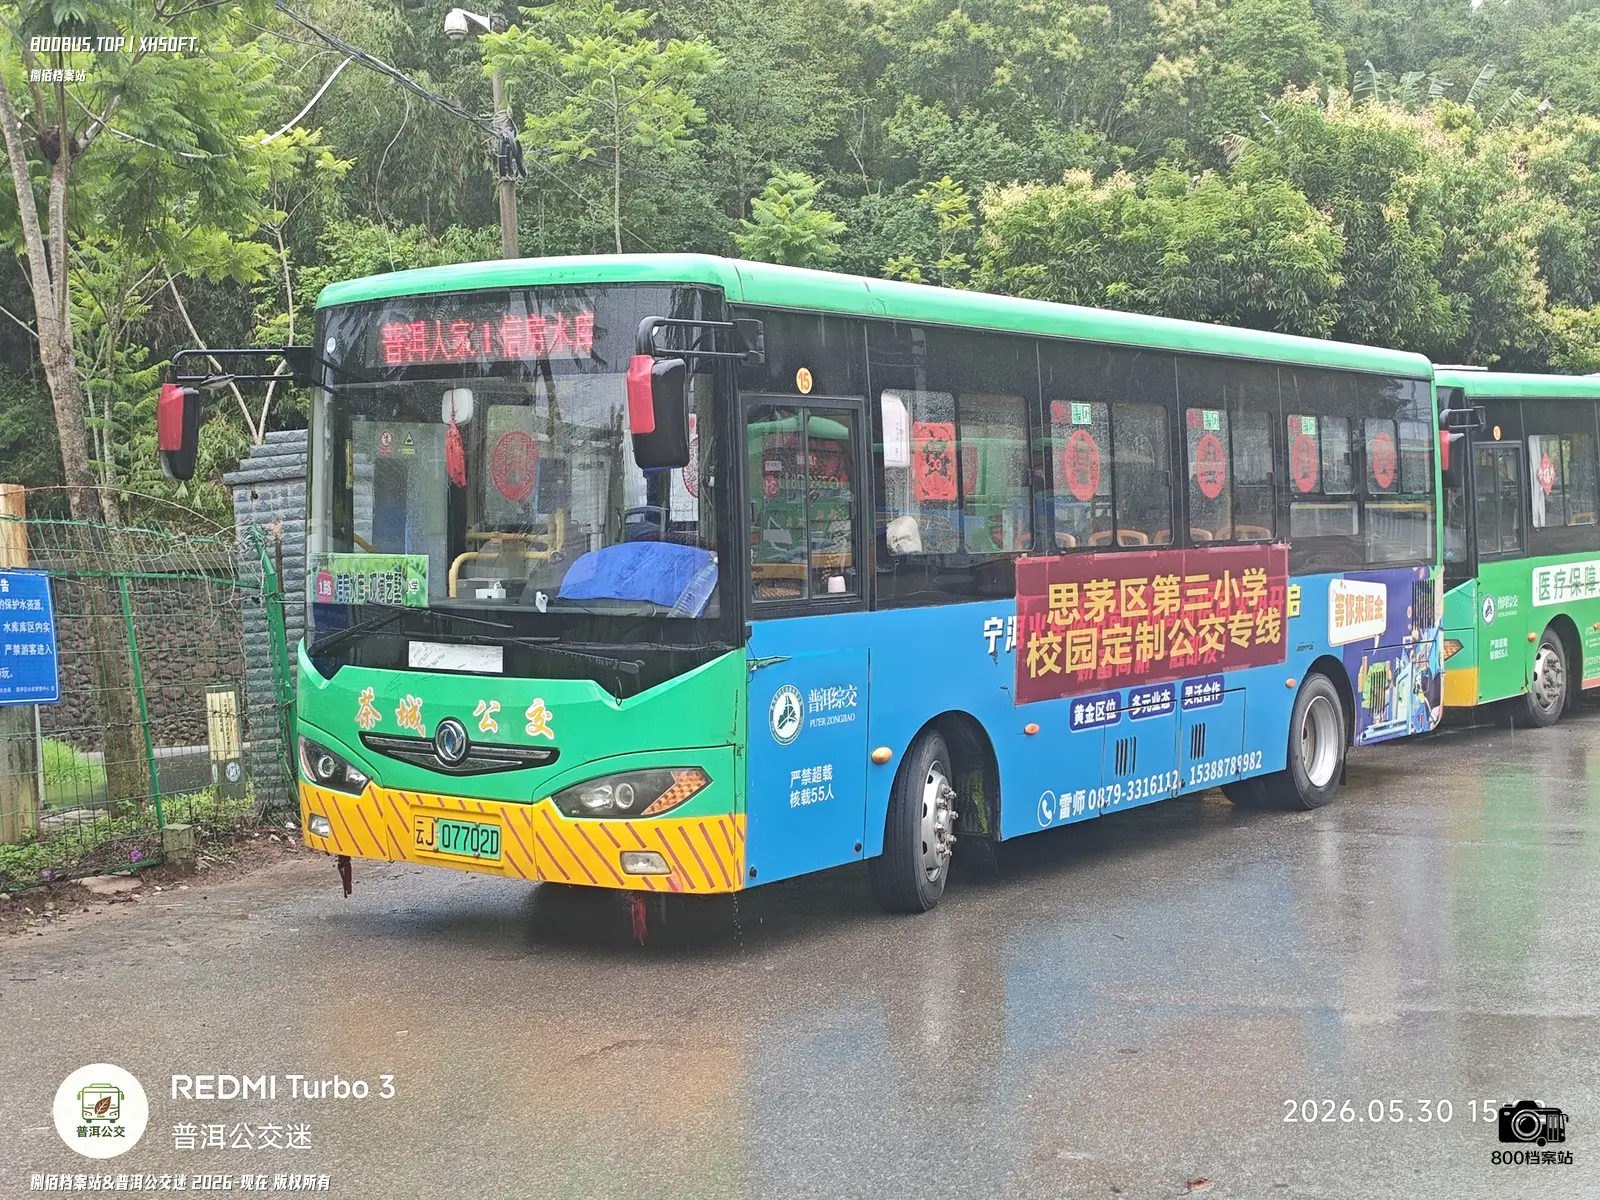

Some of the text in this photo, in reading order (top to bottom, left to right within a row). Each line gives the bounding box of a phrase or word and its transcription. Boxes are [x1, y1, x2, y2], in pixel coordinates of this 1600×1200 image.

[797, 370, 811, 391] 15
[1046, 567, 1268, 626] 思茅区第三小学
[1538, 564, 1600, 601] 医疗保障
[1026, 607, 1282, 679] 校园定制公交专线
[1073, 700, 1117, 727] 黄金区位
[790, 764, 833, 788] 严禁超载
[790, 784, 835, 809] 核载55人
[441, 823, 500, 855] 07702D
